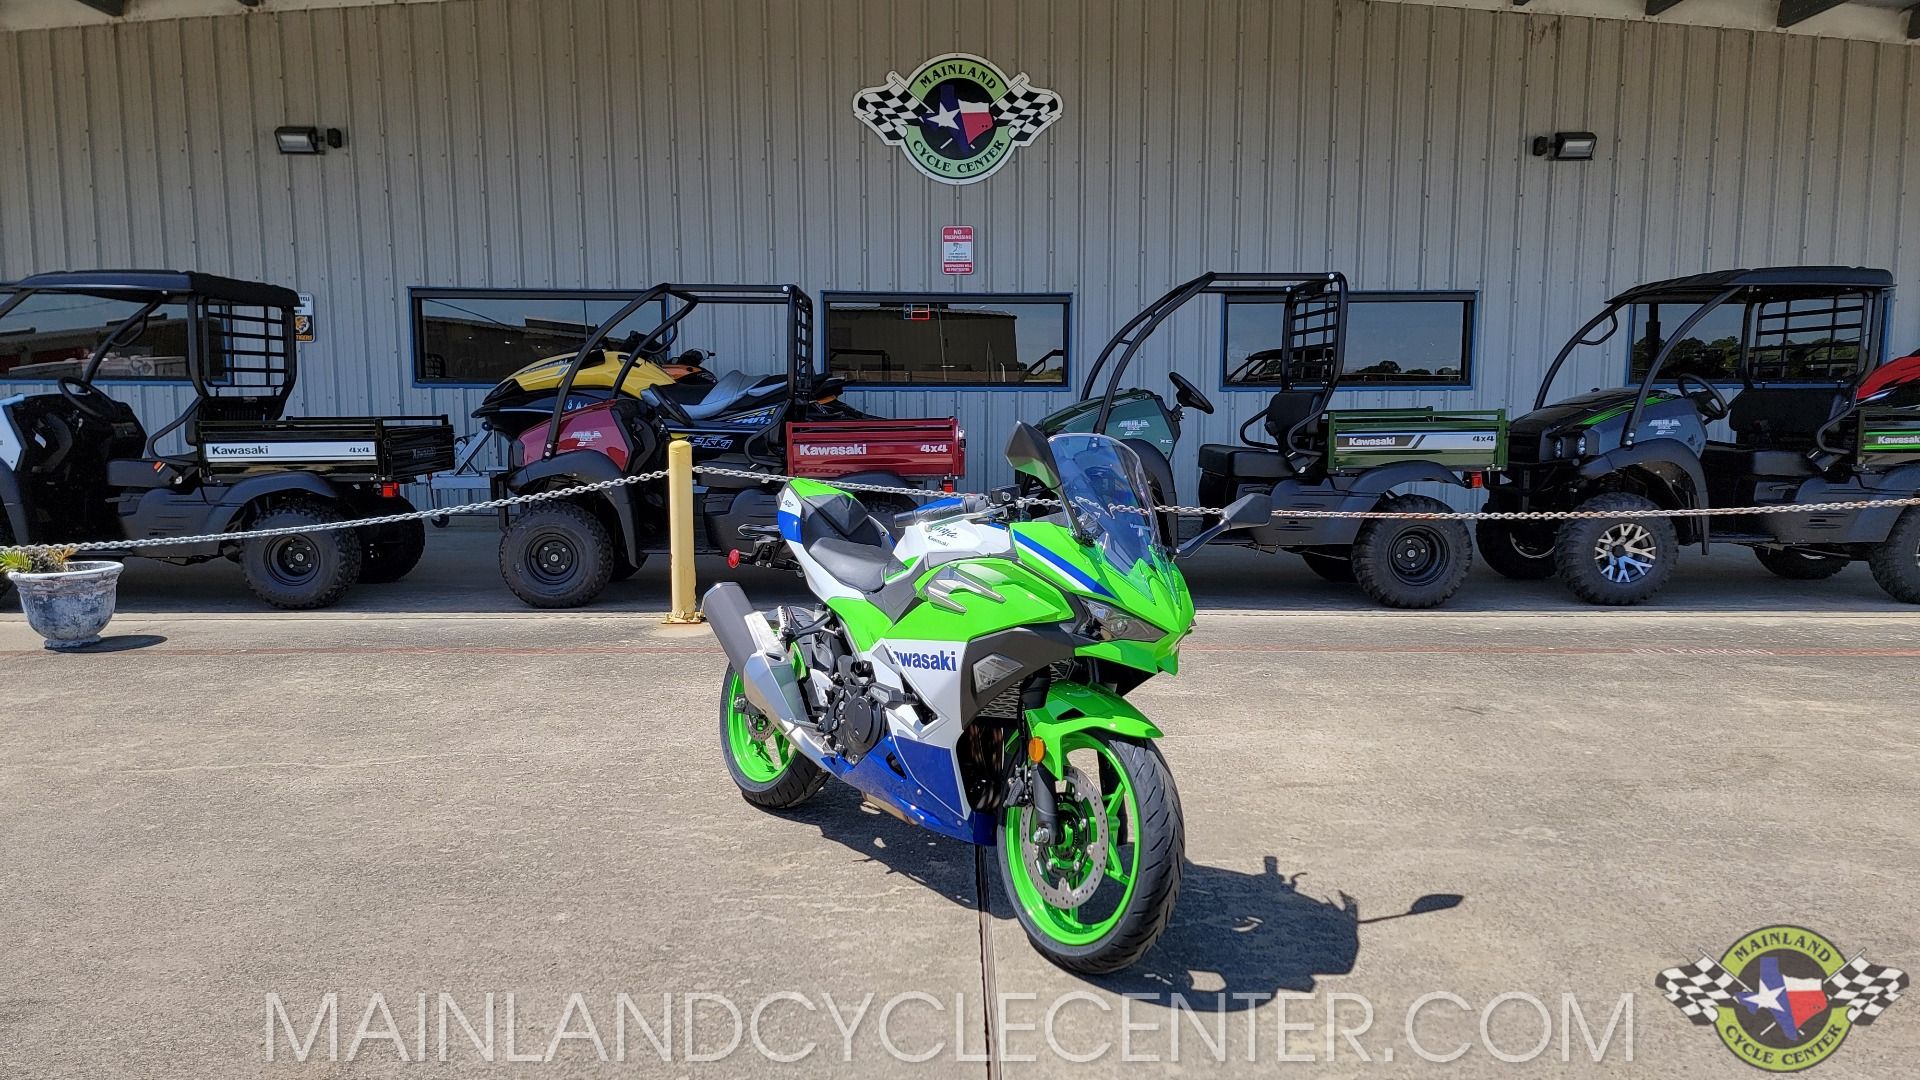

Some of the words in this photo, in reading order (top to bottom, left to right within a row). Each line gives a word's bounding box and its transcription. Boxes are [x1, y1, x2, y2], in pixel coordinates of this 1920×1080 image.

[919, 64, 997, 90] MAINLAND
[913, 139, 951, 172] CYCLE
[956, 139, 1006, 173] CENTER
[211, 445, 269, 455] Kawasaki
[799, 444, 867, 456] Kawasaki
[920, 444, 948, 453] 4x4
[1348, 436, 1396, 447] Kawasaki
[892, 650, 957, 672] wasaki
